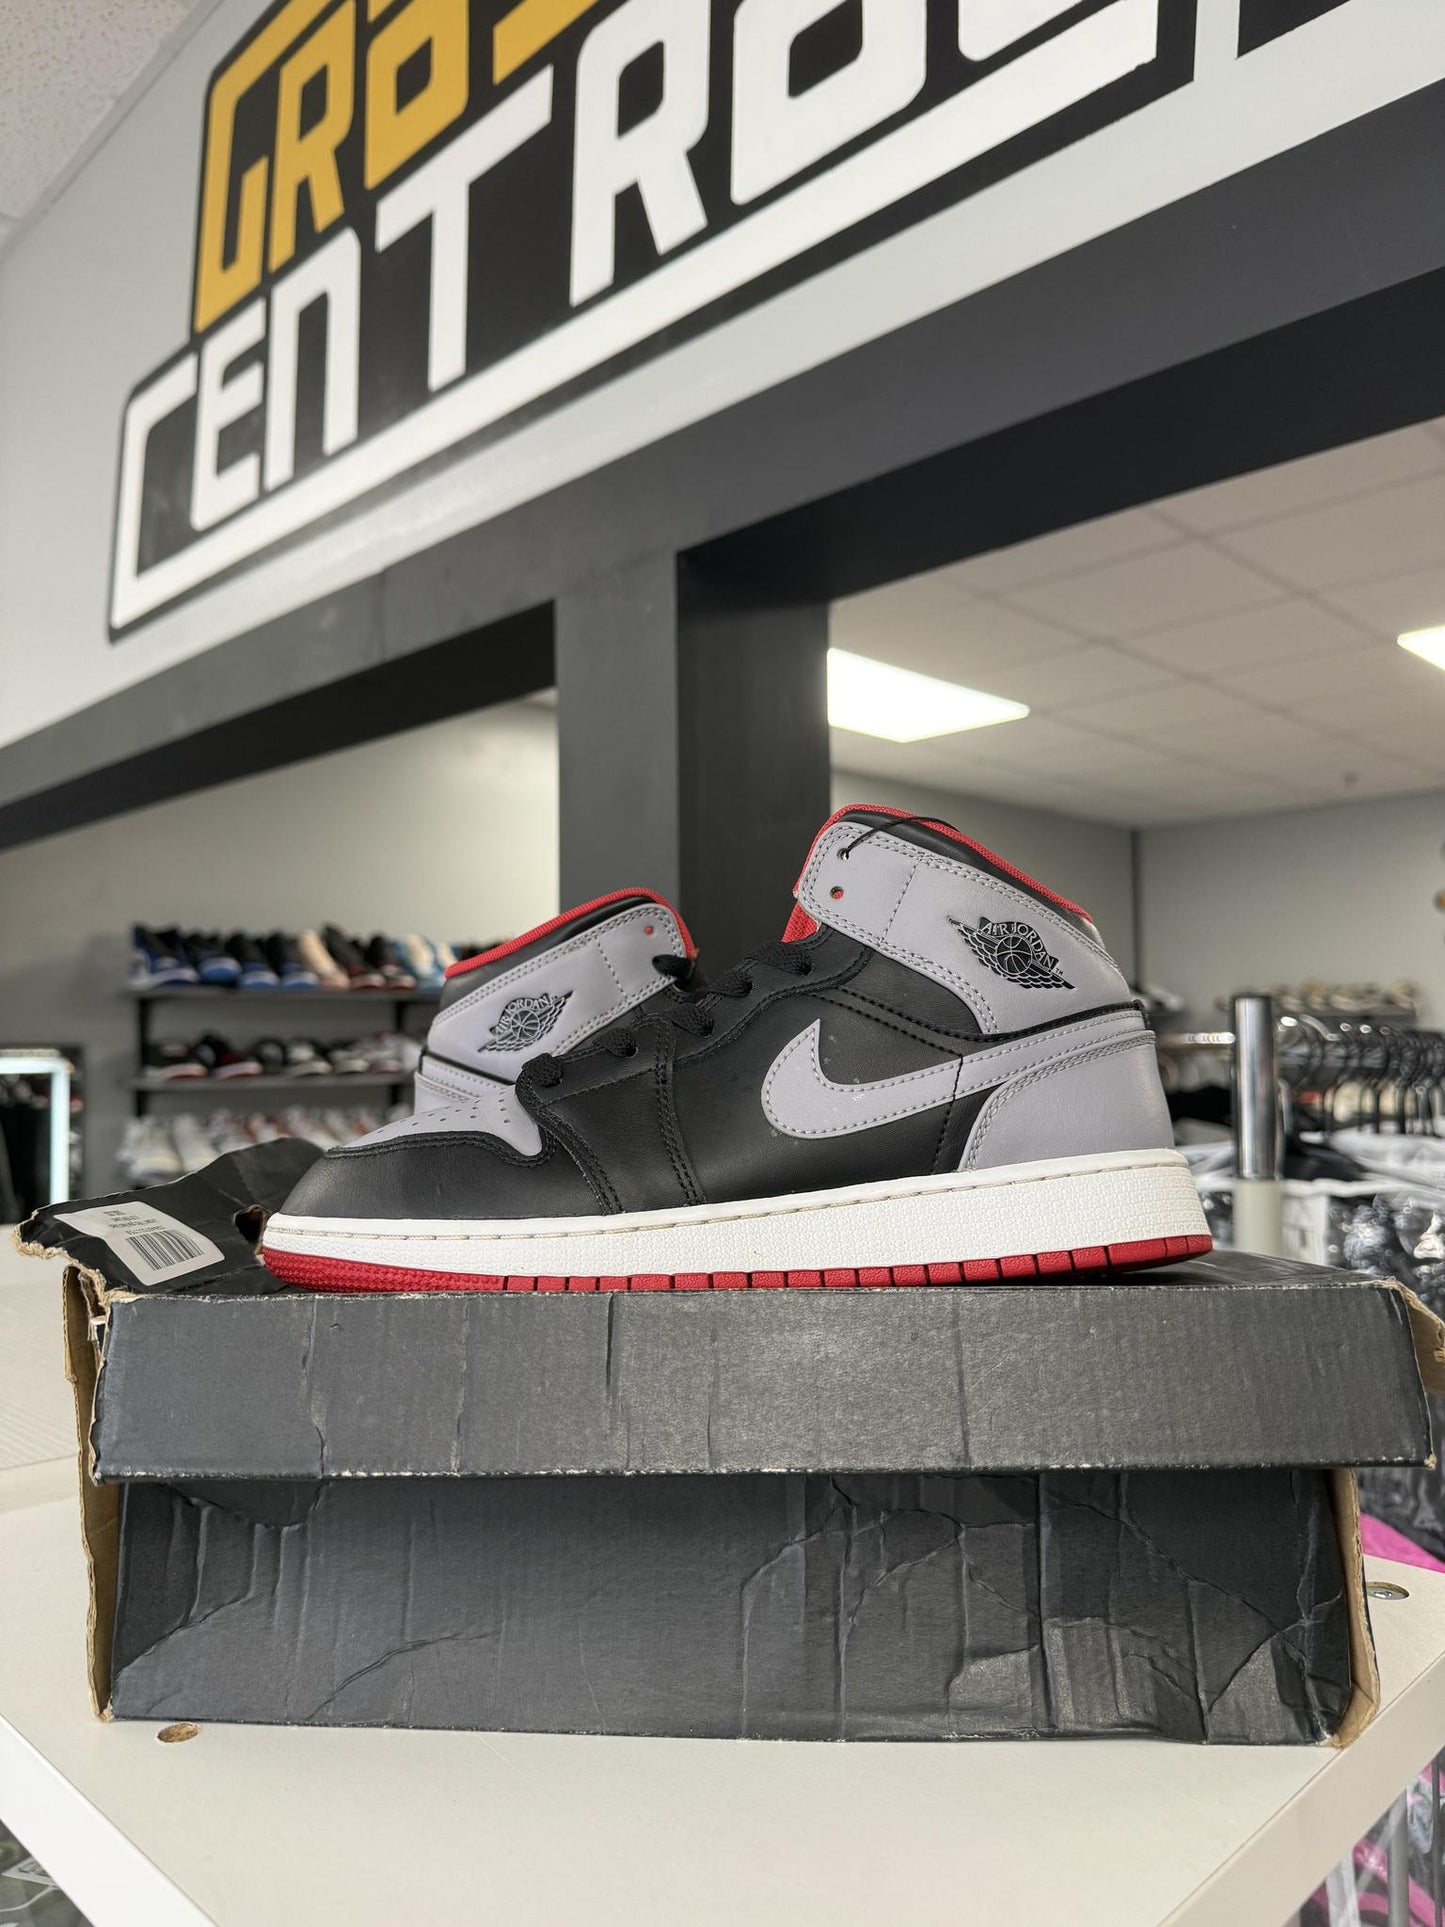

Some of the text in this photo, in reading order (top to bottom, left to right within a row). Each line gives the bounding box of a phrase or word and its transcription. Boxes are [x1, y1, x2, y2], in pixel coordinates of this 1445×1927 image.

[980, 922, 1009, 936] AIR
[1011, 922, 1055, 971] JORDAN
[505, 995, 550, 1015] JORDAN
